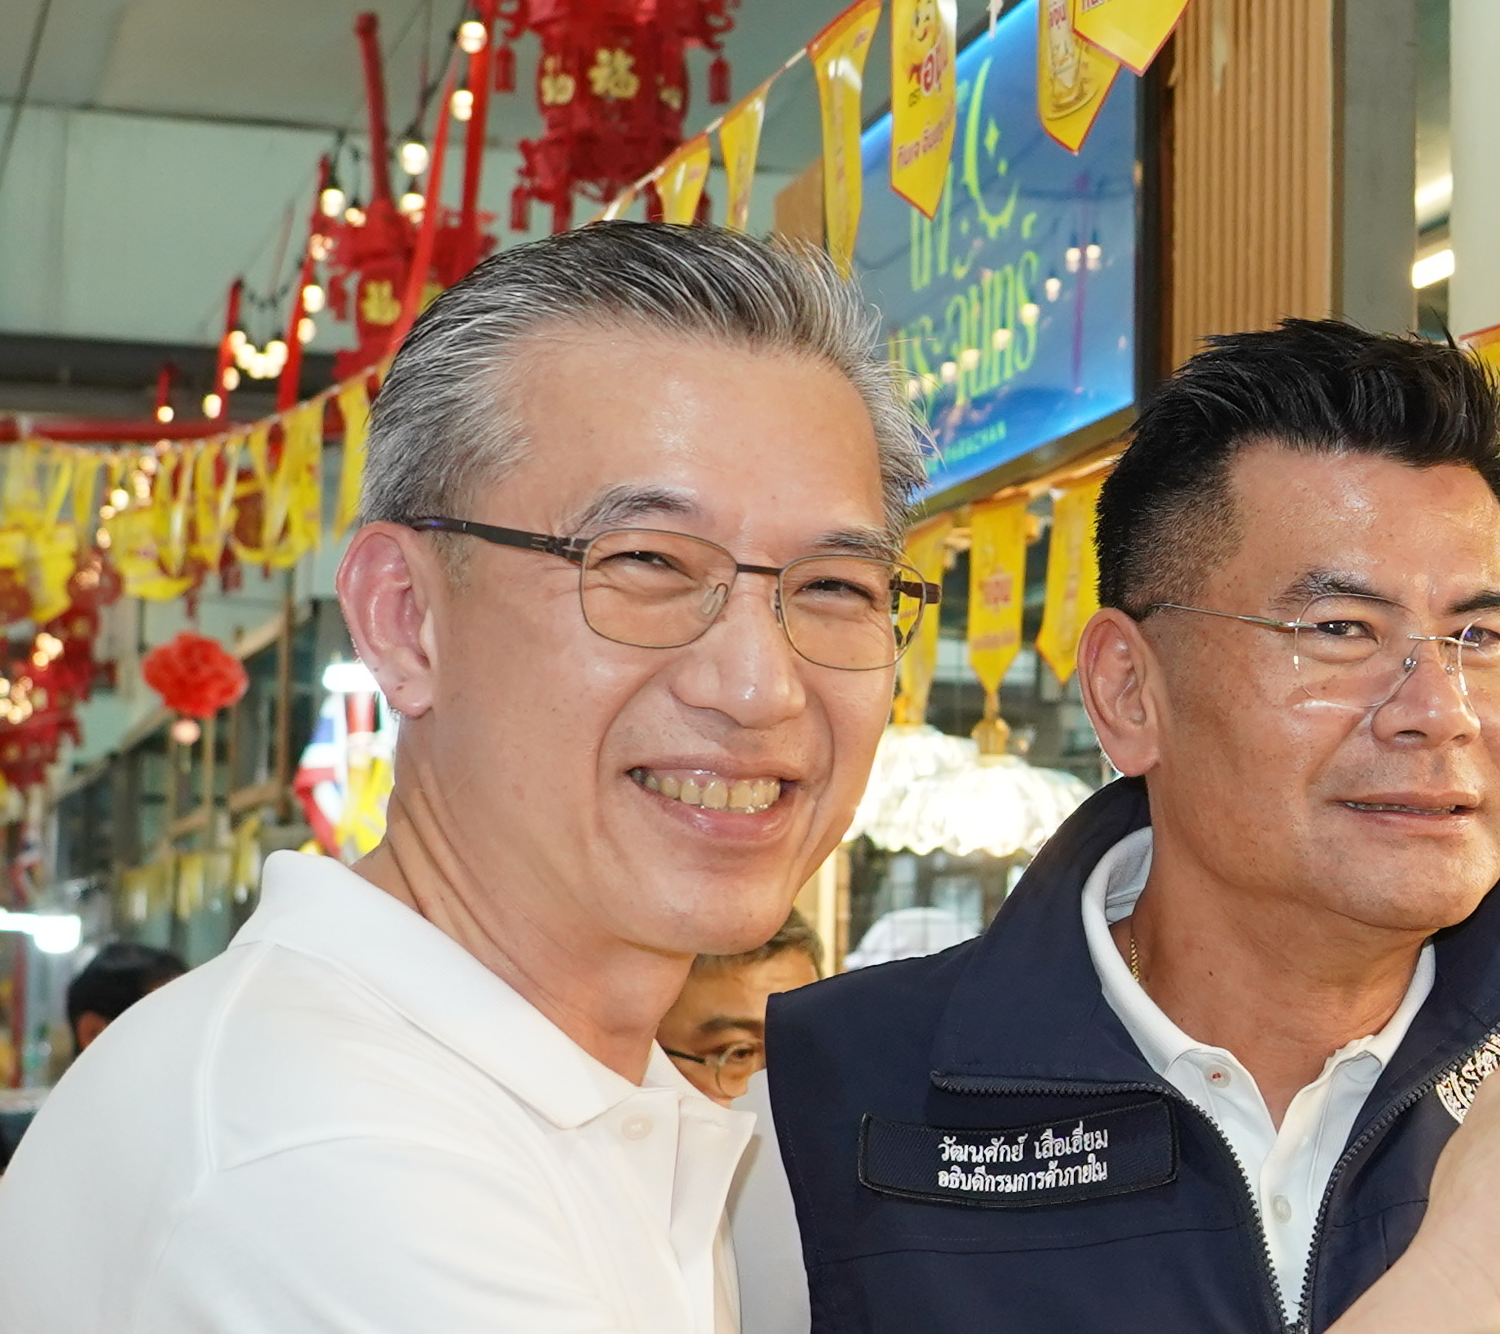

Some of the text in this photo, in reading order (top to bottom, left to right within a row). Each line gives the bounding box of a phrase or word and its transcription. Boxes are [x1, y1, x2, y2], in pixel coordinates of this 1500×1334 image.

[938, 1132, 1029, 1164] วัฒนศักย์
[937, 1152, 1108, 1194] อธิบดีกรมการค้าภายใน
